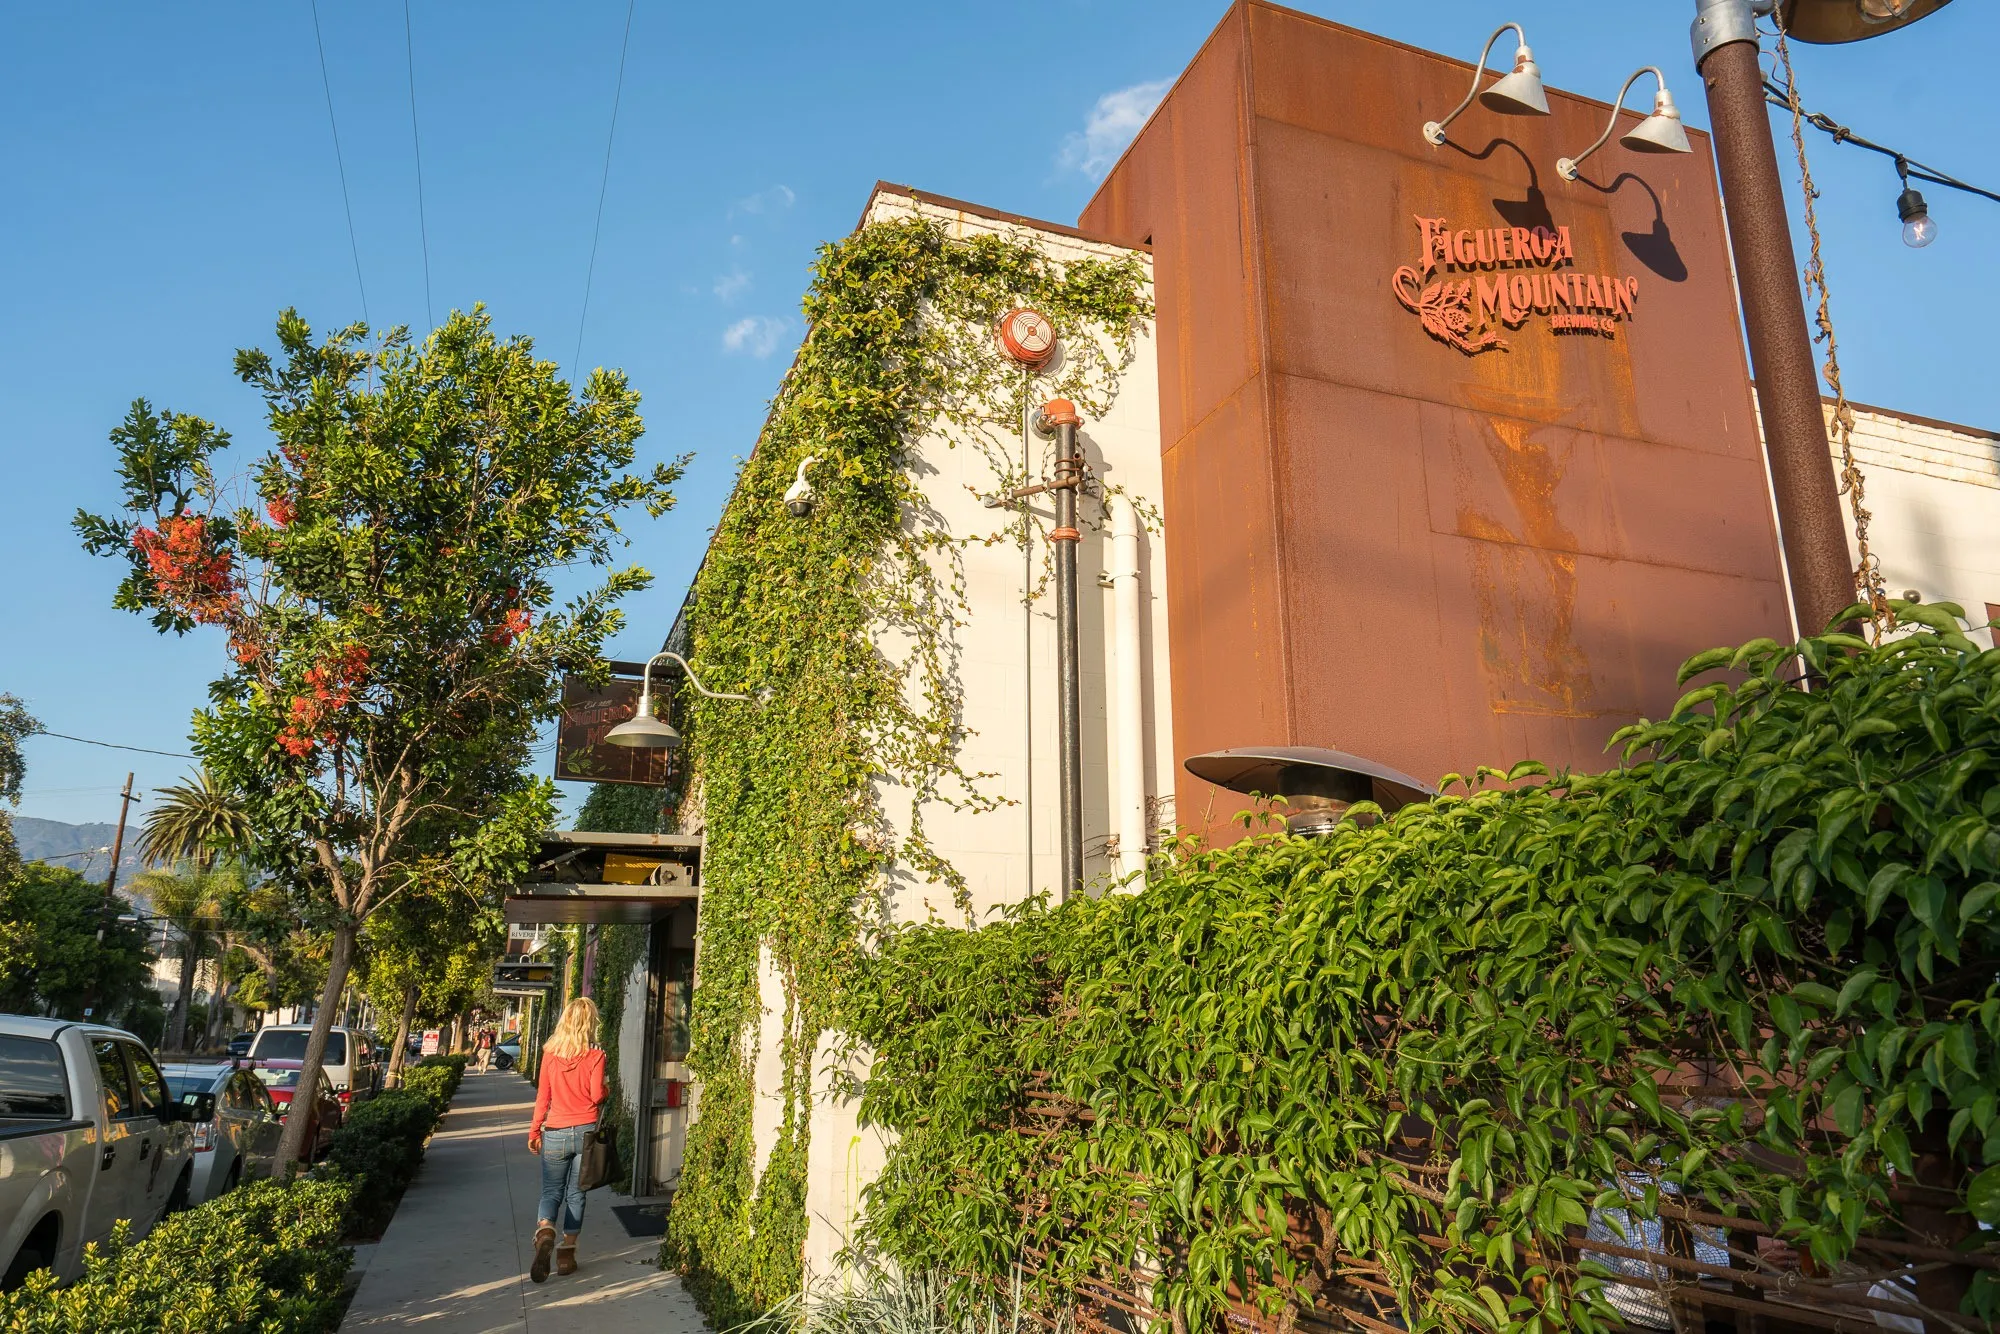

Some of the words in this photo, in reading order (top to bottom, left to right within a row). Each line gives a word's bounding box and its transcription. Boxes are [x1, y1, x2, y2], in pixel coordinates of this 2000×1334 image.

[1413, 213, 1573, 275] FIGUEROA
[1475, 273, 1638, 327] MOUNTAIN
[1551, 314, 1598, 329] BREWING
